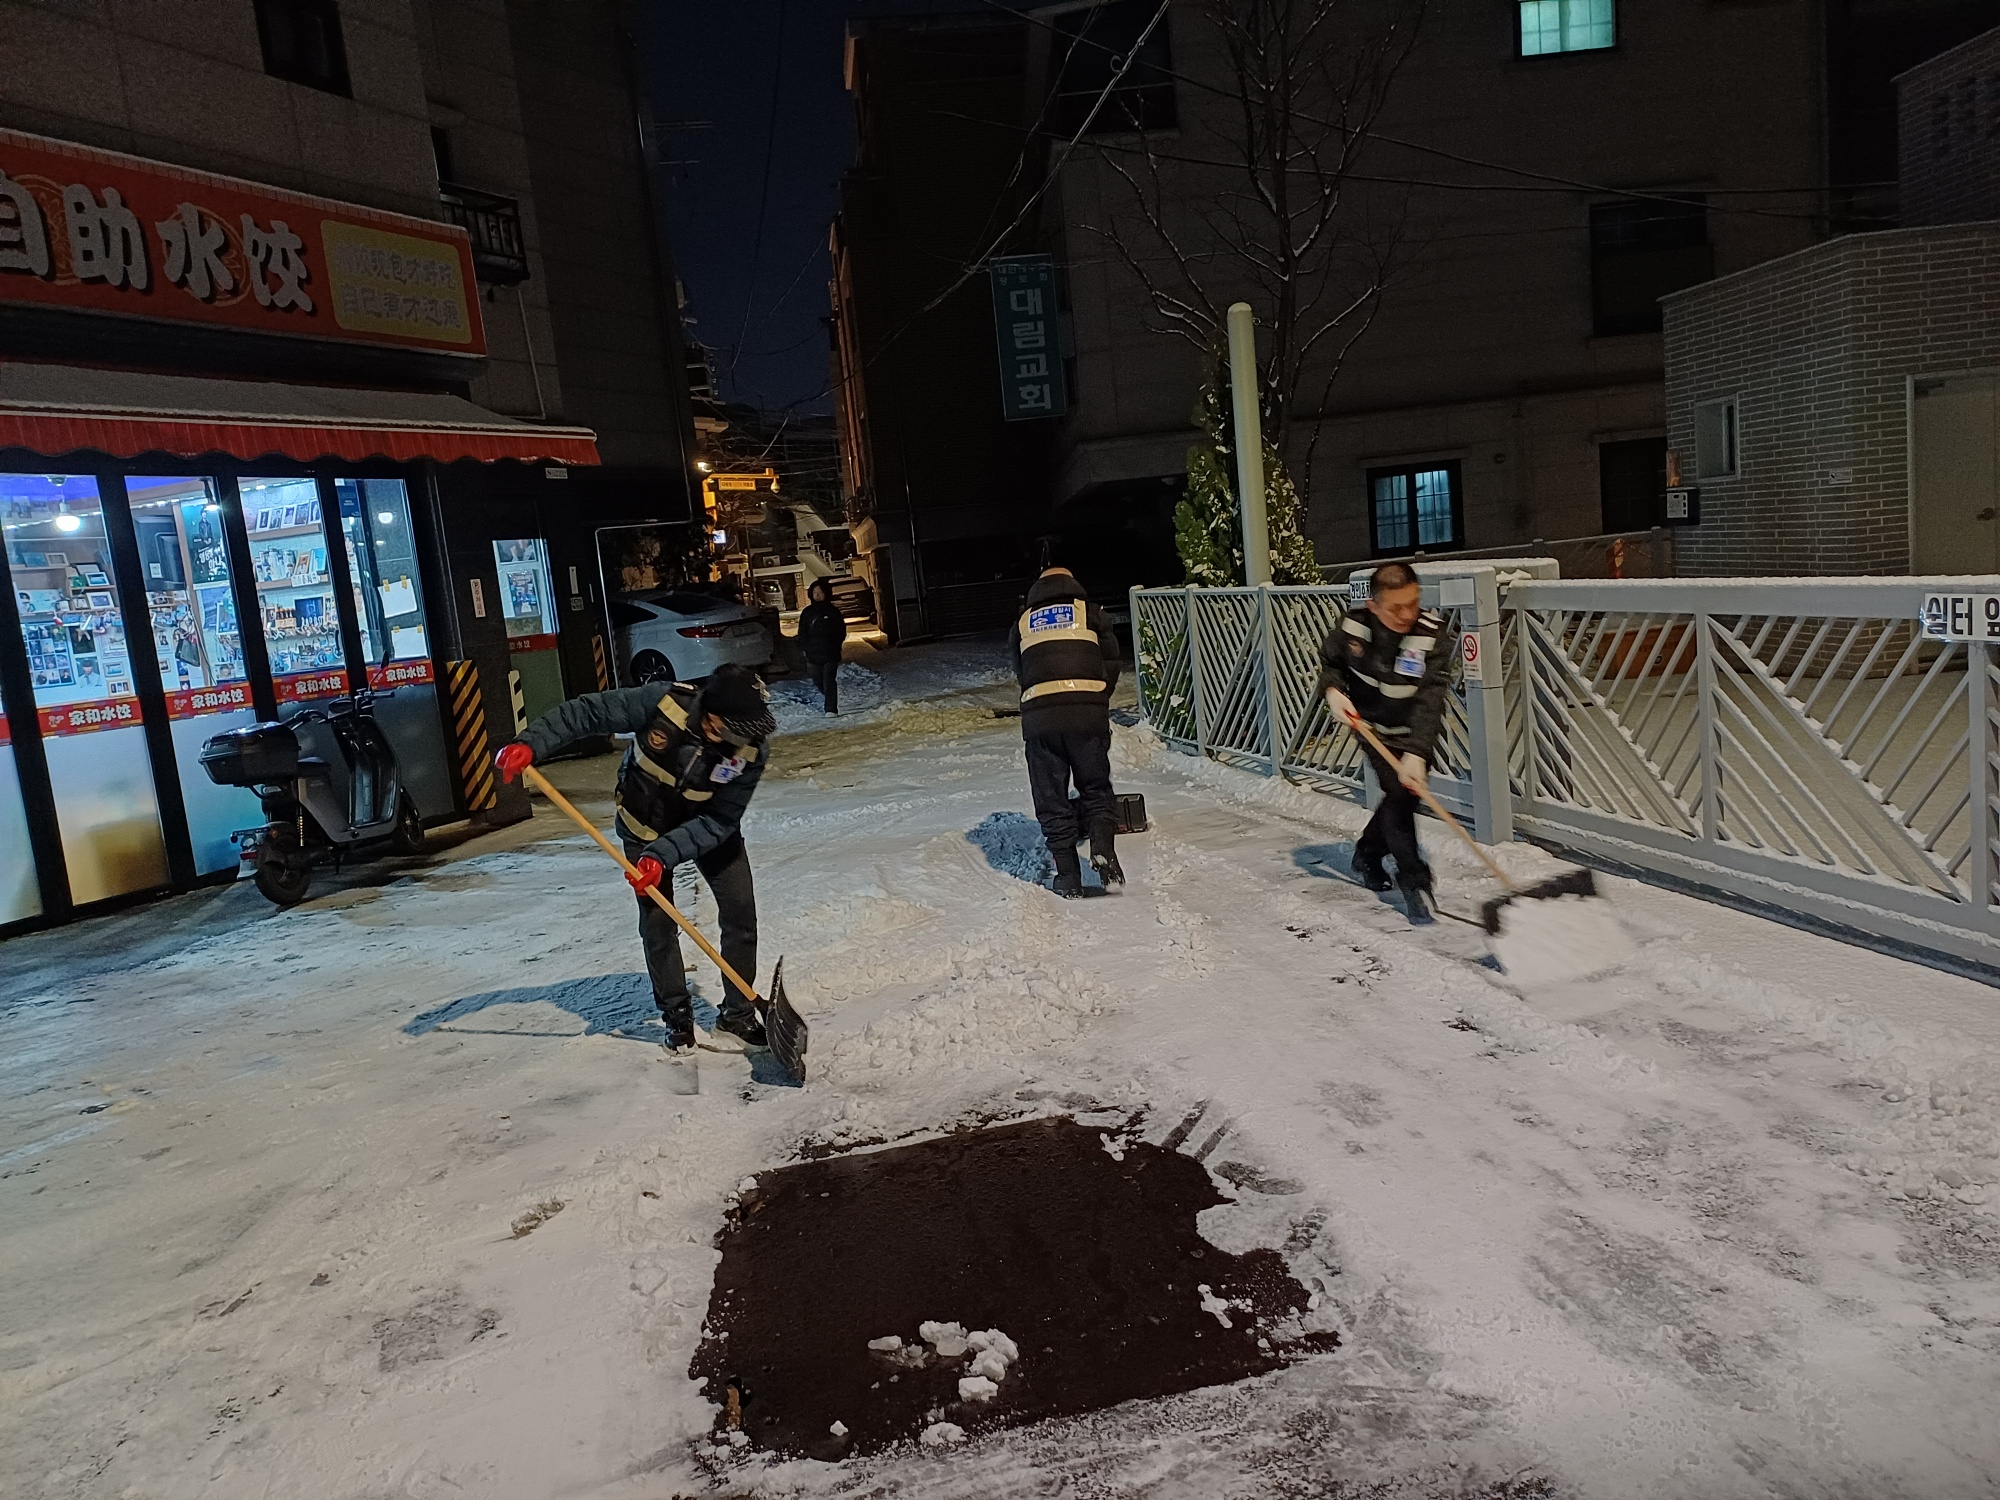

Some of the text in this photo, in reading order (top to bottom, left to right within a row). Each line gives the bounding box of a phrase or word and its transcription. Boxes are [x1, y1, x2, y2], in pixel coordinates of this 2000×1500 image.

[1009, 287, 1052, 410] 대림교회
[1926, 597, 1973, 635] 쉼터
[386, 665, 427, 682] 家和水饺
[295, 676, 342, 695] 家和水饺
[191, 688, 245, 709] 家和水饺
[69, 704, 132, 726] 家和水饺
